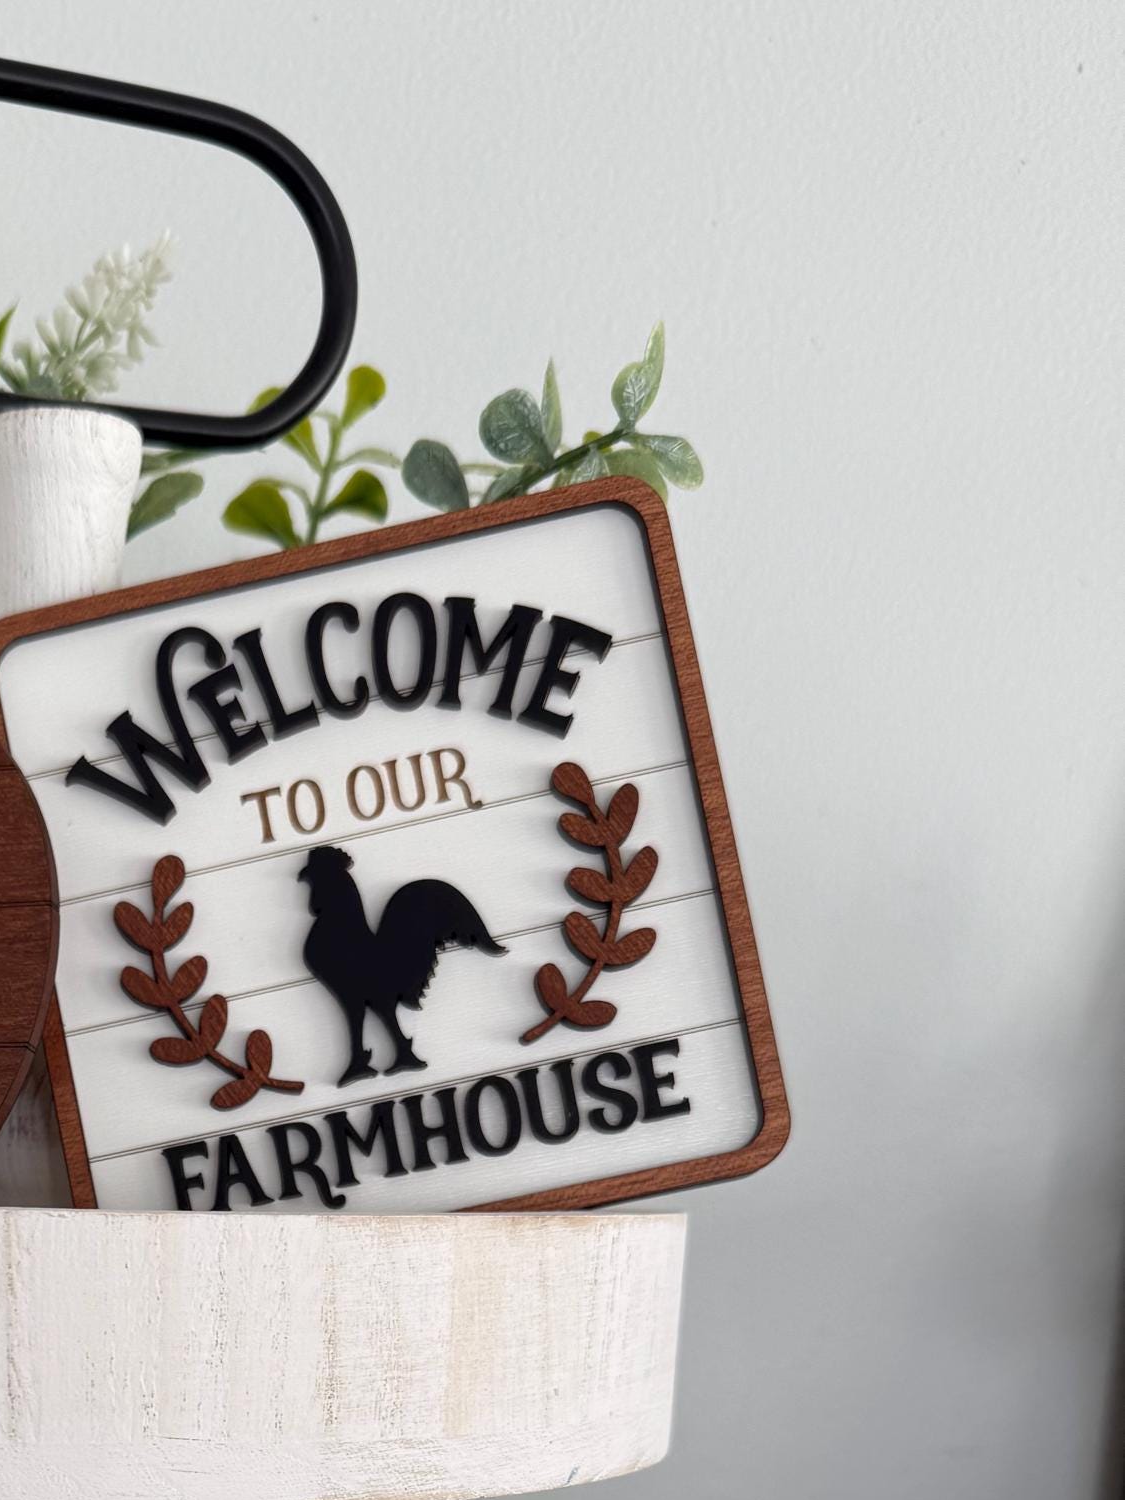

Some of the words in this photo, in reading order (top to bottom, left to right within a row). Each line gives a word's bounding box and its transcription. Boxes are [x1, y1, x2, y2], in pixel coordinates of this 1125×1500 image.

[65, 592, 613, 826] WELCOME
[240, 778, 326, 844] TO
[346, 746, 483, 822] OUR
[161, 1040, 690, 1211] FARMHOUSE
